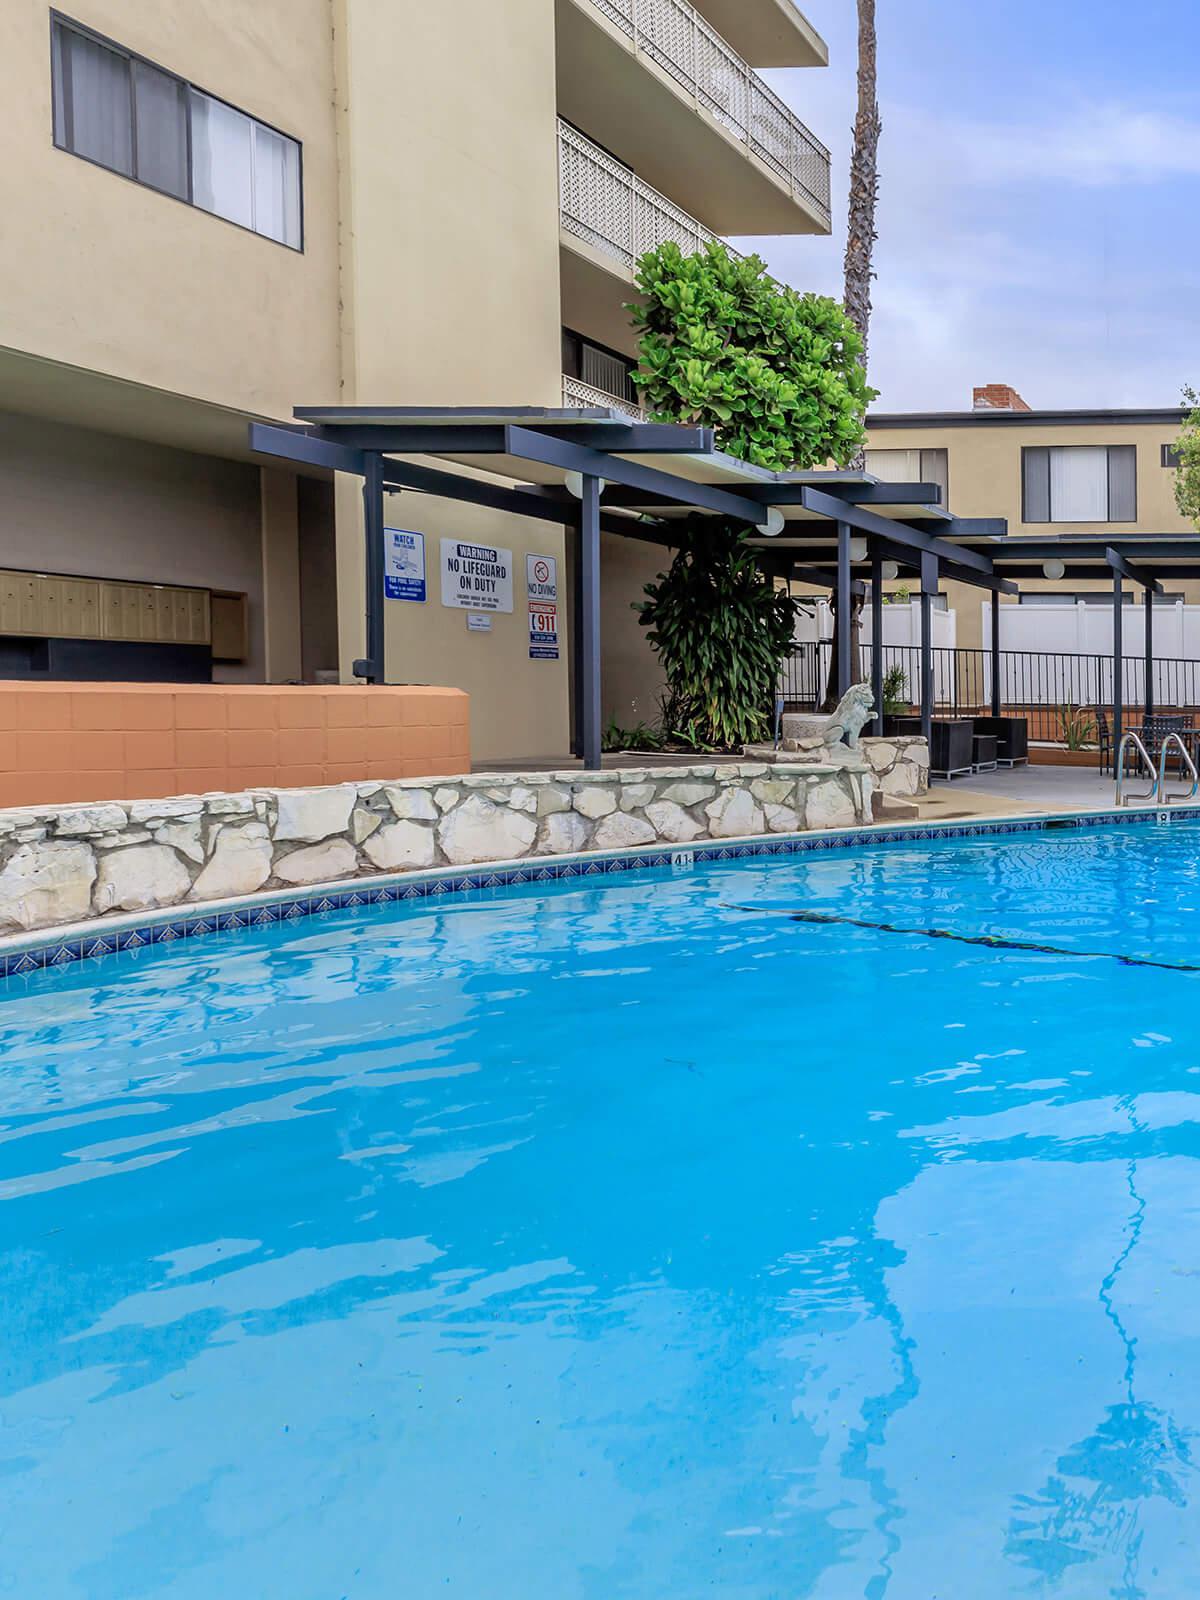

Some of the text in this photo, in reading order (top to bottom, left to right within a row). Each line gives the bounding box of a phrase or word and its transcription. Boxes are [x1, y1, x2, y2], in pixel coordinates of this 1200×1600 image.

[393, 534, 415, 545] WATCH
[459, 545, 496, 561] WARNING
[447, 558, 506, 579] NO LIFEGUARD
[460, 575, 496, 593] ON DUTY
[528, 583, 556, 596] NO DIVING
[538, 614, 555, 632] 911
